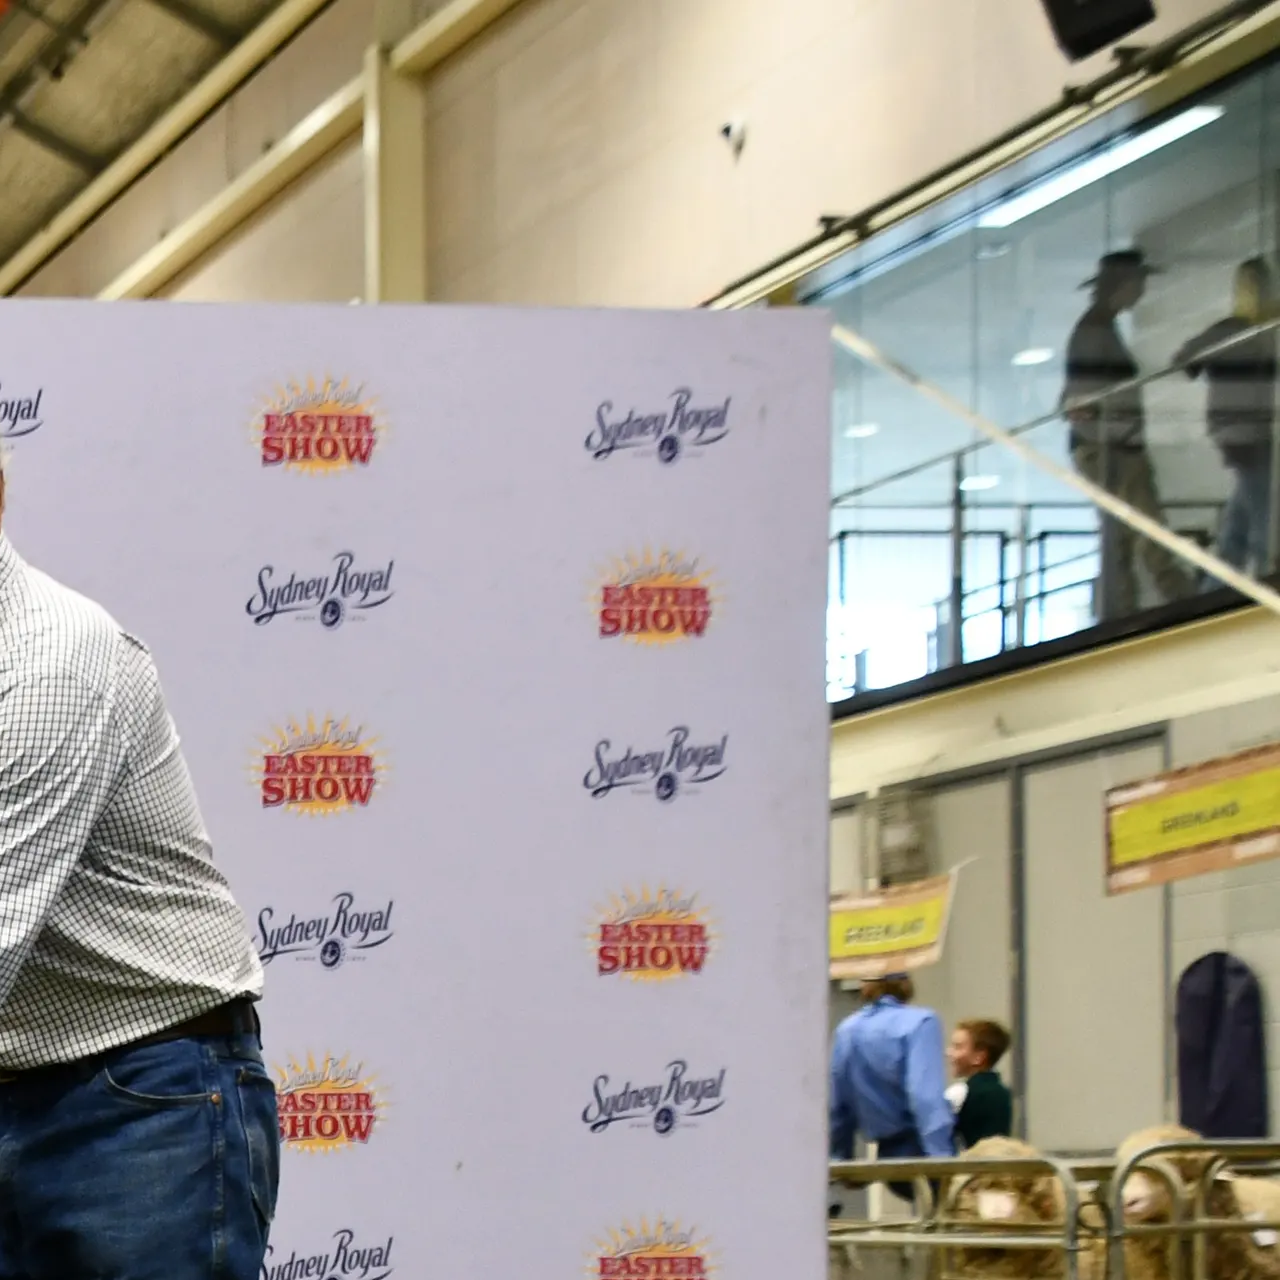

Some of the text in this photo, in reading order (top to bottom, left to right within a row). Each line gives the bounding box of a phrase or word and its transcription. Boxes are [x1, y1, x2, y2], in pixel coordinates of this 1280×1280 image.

[263, 413, 376, 435] EASTER
[584, 387, 730, 459] Sydney Royal
[262, 436, 376, 466] SHOW
[245, 552, 394, 624] Sydney Royal
[601, 586, 709, 607] EASTER
[599, 608, 711, 638] SHOW
[263, 755, 375, 776] EASTER
[583, 725, 728, 797] Sydney Royal
[262, 776, 375, 808] SHOW
[252, 892, 394, 965] Sydney Royal
[598, 923, 708, 944] EASTER
[598, 945, 709, 976] SHOW
[277, 1092, 376, 1113] ASTER
[582, 1060, 725, 1132] Sydney Royal
[329, 1229, 393, 1280] Royal
[598, 1256, 706, 1277] EASTER
